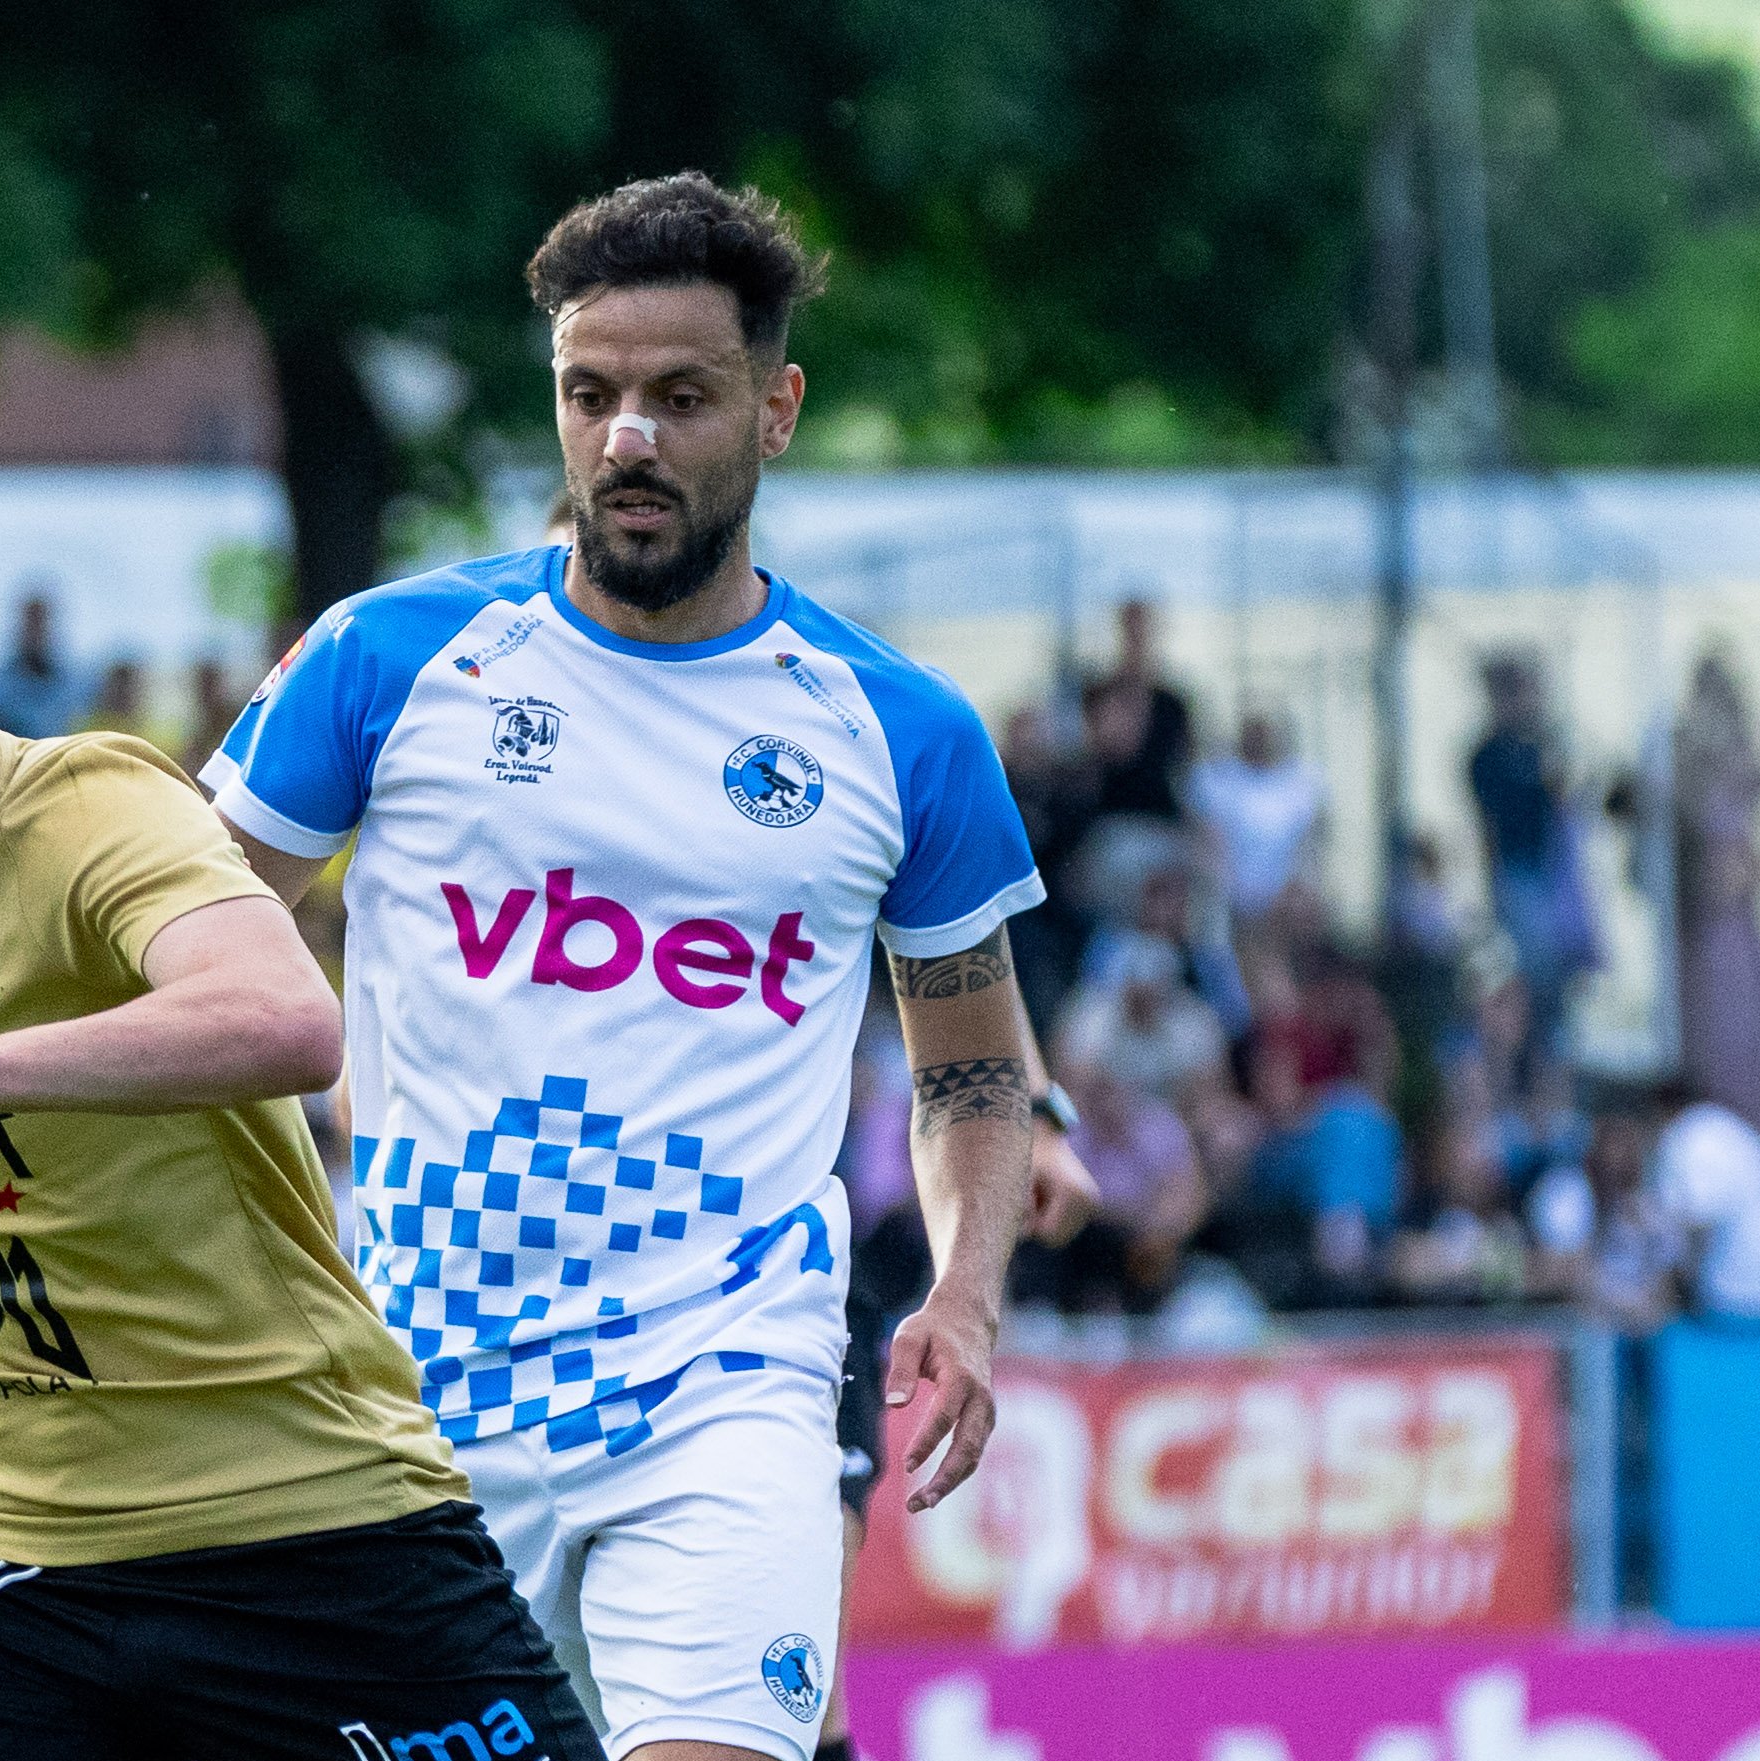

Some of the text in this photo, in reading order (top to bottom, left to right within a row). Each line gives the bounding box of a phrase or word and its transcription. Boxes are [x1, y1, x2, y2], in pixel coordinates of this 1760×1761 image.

[481, 617, 545, 668] HUNEDOARA
[788, 668, 860, 740] HUNEDOARA
[756, 738, 818, 777] CORVINUL
[731, 787, 814, 824] HUNEDOARA
[440, 866, 815, 1028] vbet
[1109, 1368, 1522, 1546] casa
